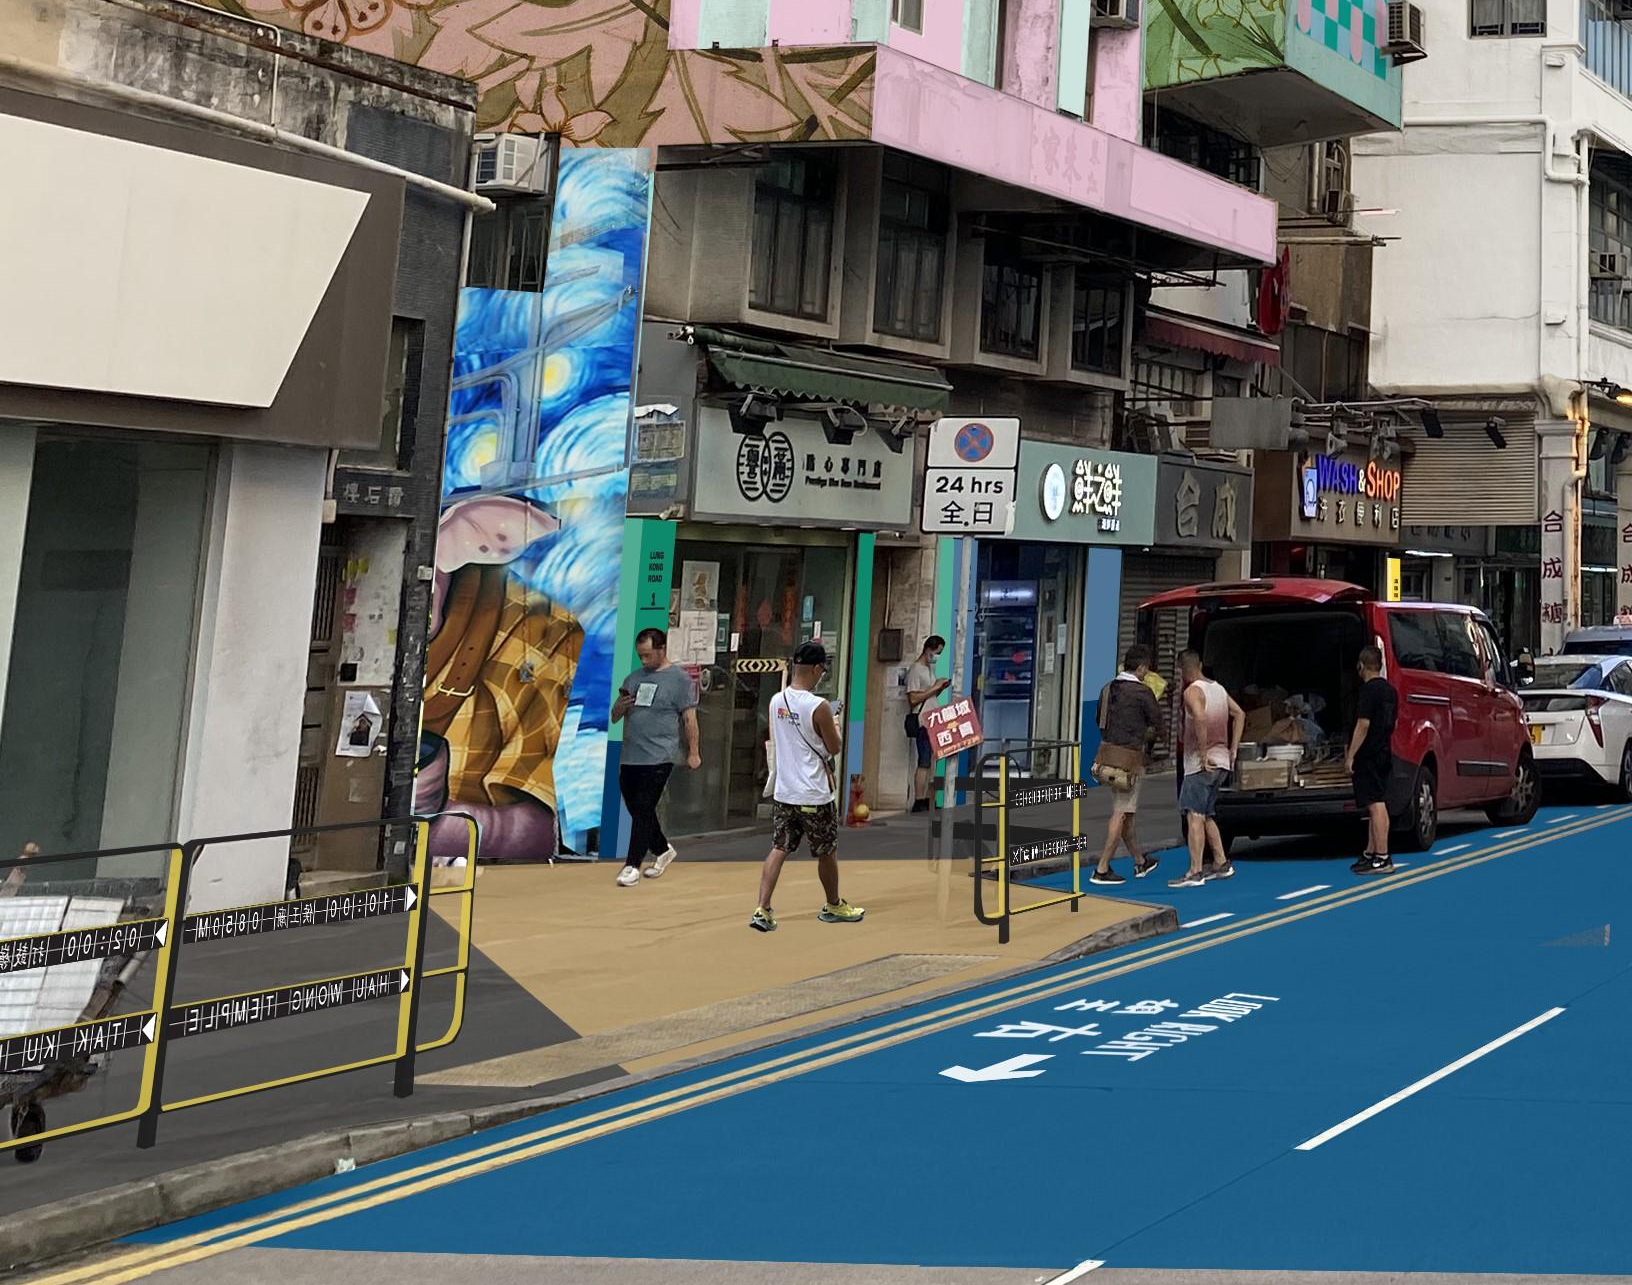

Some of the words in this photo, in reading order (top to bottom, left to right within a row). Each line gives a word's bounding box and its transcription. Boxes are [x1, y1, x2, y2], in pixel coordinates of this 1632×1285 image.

[936, 477, 963, 493] 24
[971, 477, 1004, 494] hrs
[649, 563, 663, 571] KONG
[1542, 510, 1563, 656] 合成糖
[651, 593, 656, 606] 1
[928, 700, 971, 727] 九龍城
[1079, 1021, 1219, 1062] RIGHT
